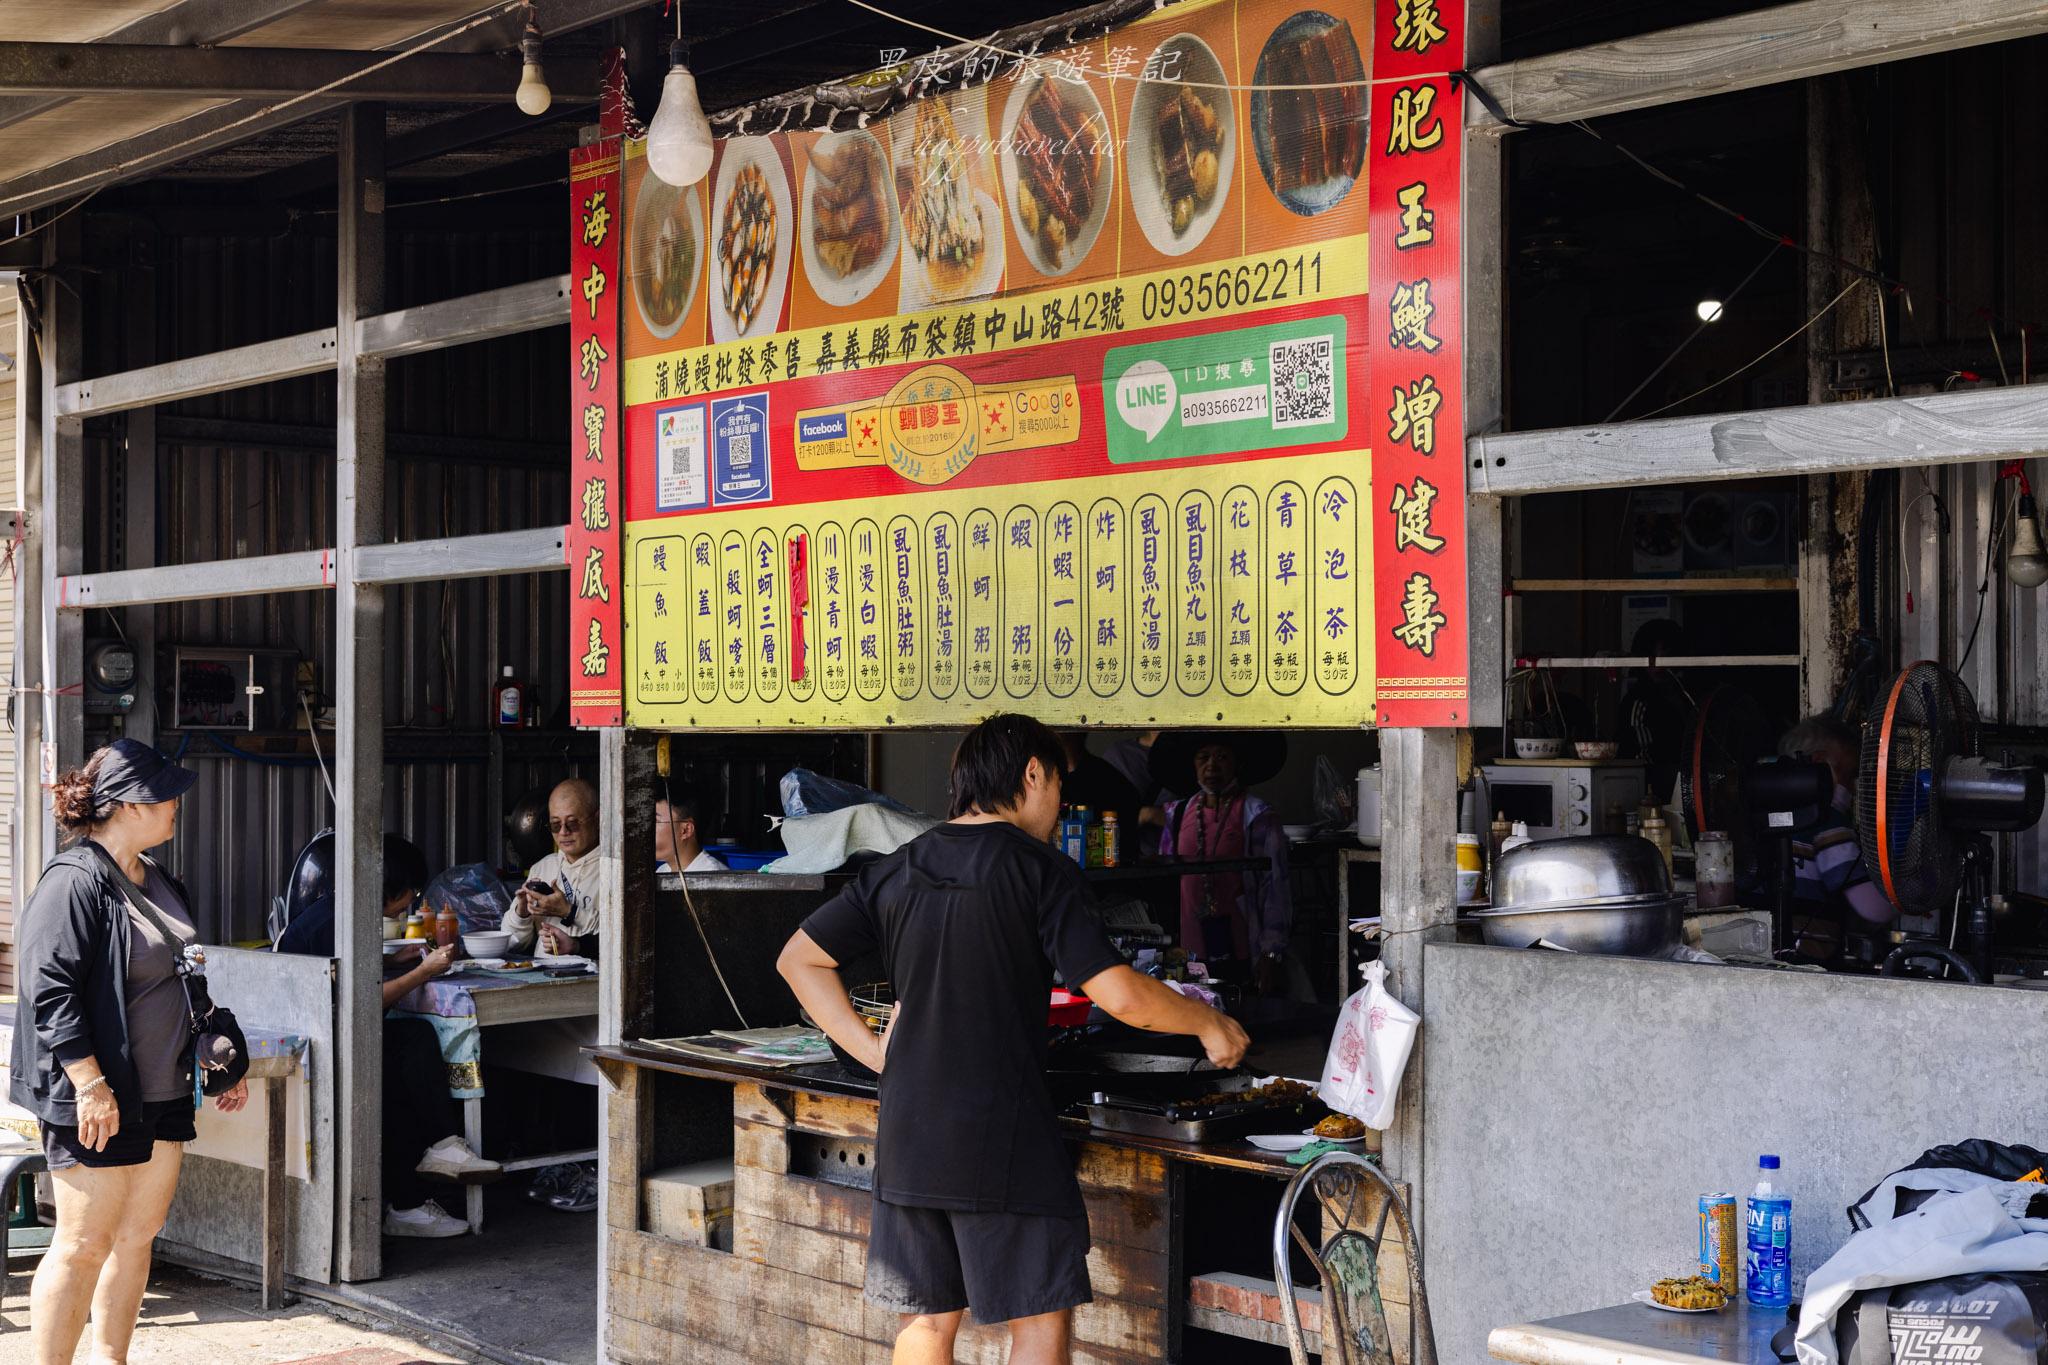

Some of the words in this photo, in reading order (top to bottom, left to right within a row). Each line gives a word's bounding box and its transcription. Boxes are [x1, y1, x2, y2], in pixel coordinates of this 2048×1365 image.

[655, 337, 801, 400] 蒲燒鰻批發零售
[816, 286, 1125, 376] 嘉義縣布袋鎮中山路42號
[1142, 251, 1323, 321] 0935662211
[906, 380, 953, 403] 布袋
[1126, 384, 1167, 409] LINE
[1016, 391, 1074, 414] Google
[1183, 394, 1268, 419] a0935662211
[727, 414, 751, 427] 我們有
[803, 420, 843, 436] facebook
[1018, 415, 1070, 436] 搜尋5000以上
[579, 189, 612, 677] 海中珍寶攏底嘉
[798, 441, 852, 459] 打卡1200顆以上
[1184, 502, 1207, 622] 虱目魚丸
[1229, 500, 1251, 625] 花枝丸
[1275, 491, 1298, 646] 青草茶
[1322, 489, 1349, 640] 冷泡茶
[971, 522, 992, 653] 鮮蚵粥
[1011, 518, 1032, 656] 蝦粥
[1053, 512, 1075, 656] 炸蝦一份
[1096, 510, 1118, 647] 炸蚵酥
[1140, 506, 1161, 651] 虱目魚丸湯
[824, 533, 842, 661] 川燙青蚵
[858, 530, 878, 660] 川燙白蝦
[894, 526, 914, 657] 虱目魚肚粥
[933, 523, 953, 657] 虱目魚肚湯
[653, 544, 669, 665] 鰻魚飯
[695, 541, 713, 664] 蝦蓋飯
[756, 540, 776, 664] 全蚵三層
[898, 661, 916, 674] 每份
[934, 660, 953, 673] 每份
[972, 659, 992, 672] 每碗
[1011, 659, 1032, 672] 每碗
[1053, 657, 1074, 671] 每份
[1095, 657, 1119, 671] 每份
[1140, 655, 1162, 669] 每碗
[1183, 653, 1207, 669] 每串
[1229, 652, 1252, 668] 每串
[1273, 652, 1298, 668] 每瓶
[1322, 650, 1349, 667] 每瓶
[643, 669, 651, 680] 大
[659, 668, 666, 680] 中
[675, 668, 682, 680] 小
[698, 667, 715, 679] 每碗
[729, 666, 745, 678] 每份
[761, 666, 778, 679] 每個
[826, 665, 844, 678] 每份
[860, 664, 879, 677] 每份
[1274, 669, 1298, 681] 30元
[1324, 668, 1349, 681] 30元
[673, 682, 685, 692] 100
[1747, 1209, 1764, 1227] IN
[1933, 1345, 1983, 1361] OUT
